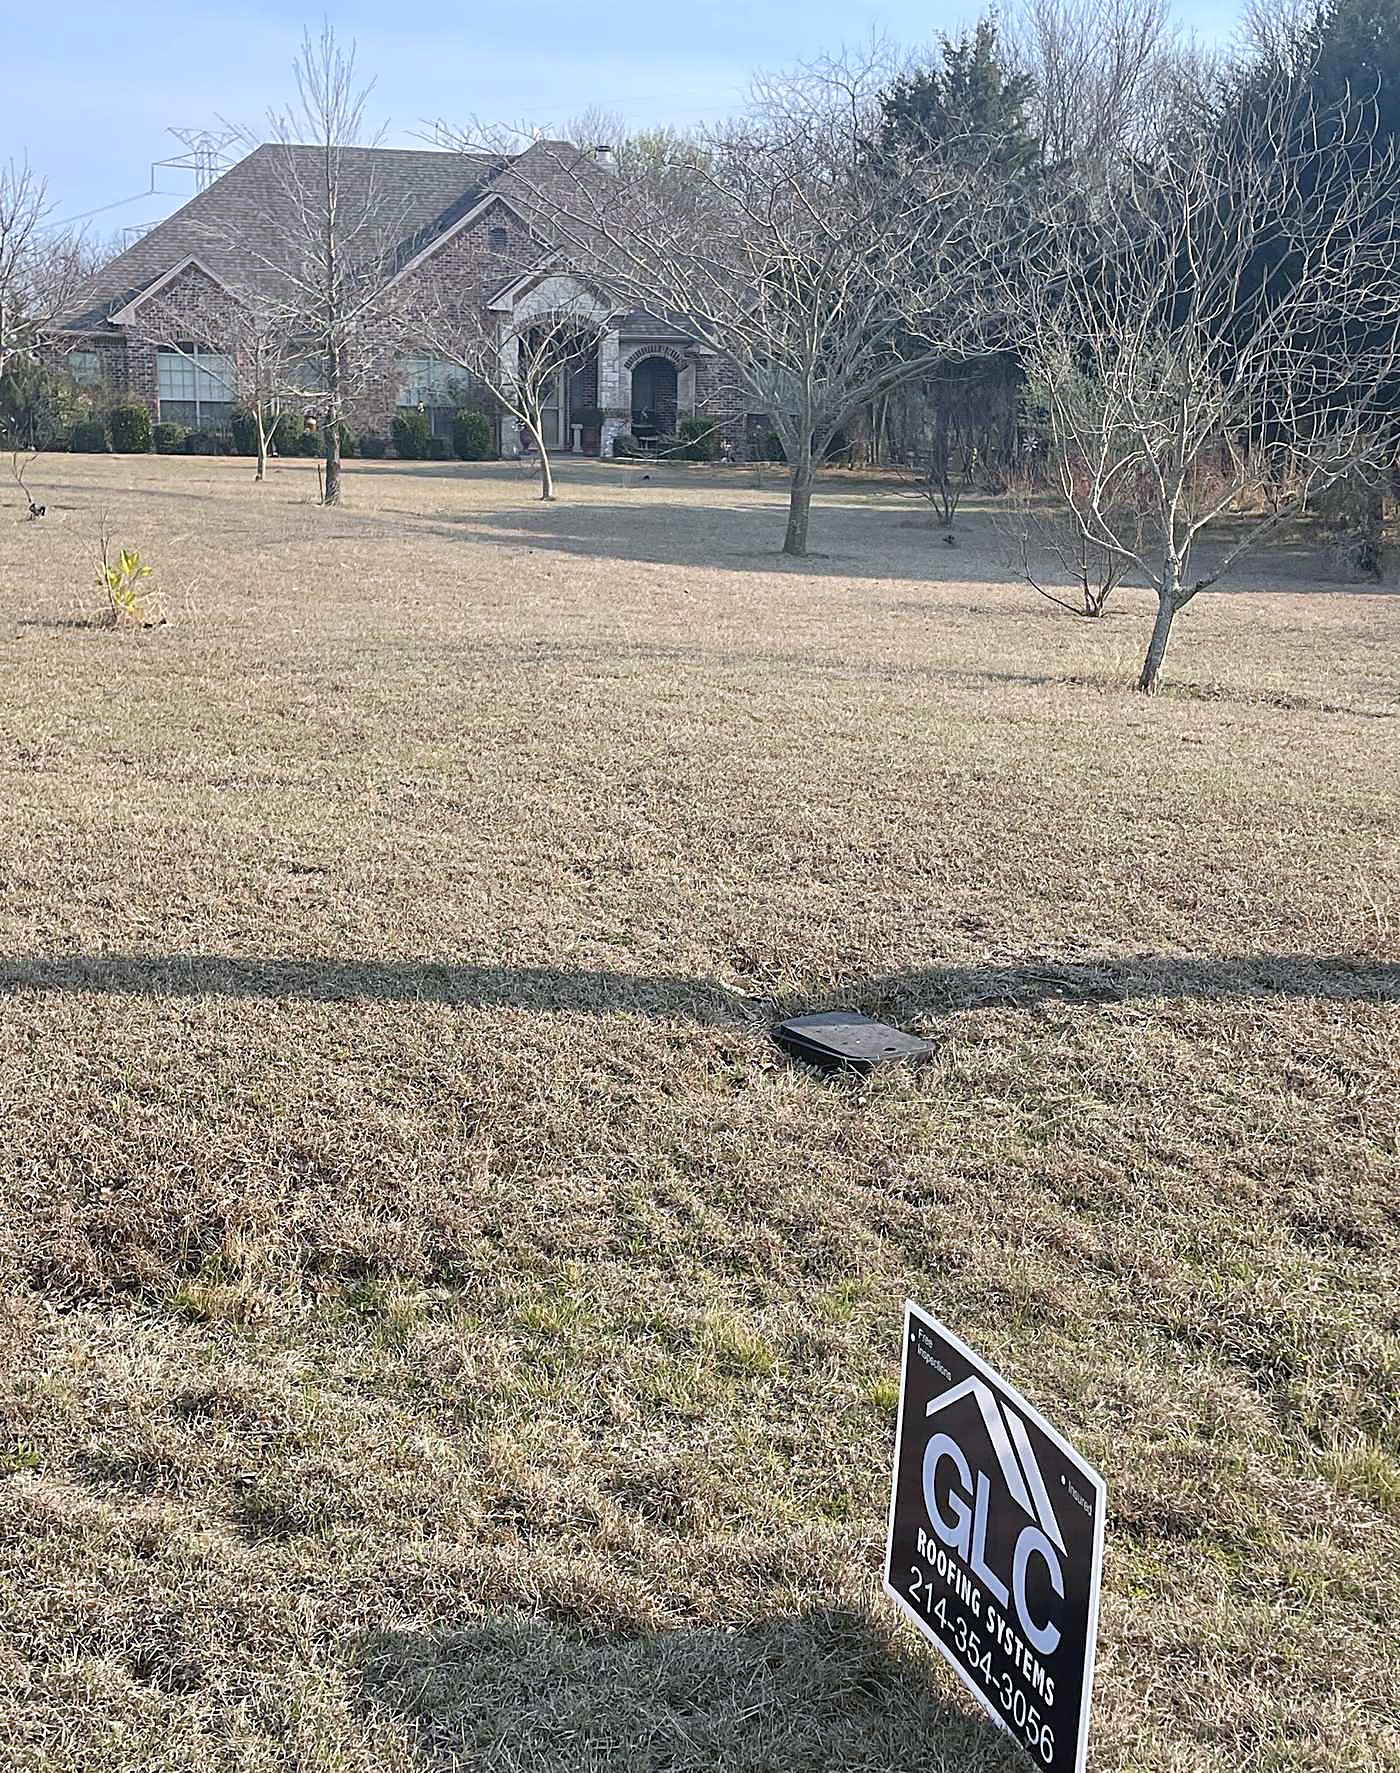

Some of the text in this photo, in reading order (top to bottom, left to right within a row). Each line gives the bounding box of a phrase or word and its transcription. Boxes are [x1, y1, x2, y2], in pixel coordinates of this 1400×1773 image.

[917, 1328, 934, 1349] Free
[922, 1432, 1065, 1655] GLC
[1067, 1480, 1093, 1517] Insured
[908, 1566, 1055, 1764] 214-354-3056
[917, 1527, 1055, 1707] ROOFING SYSTEMS
